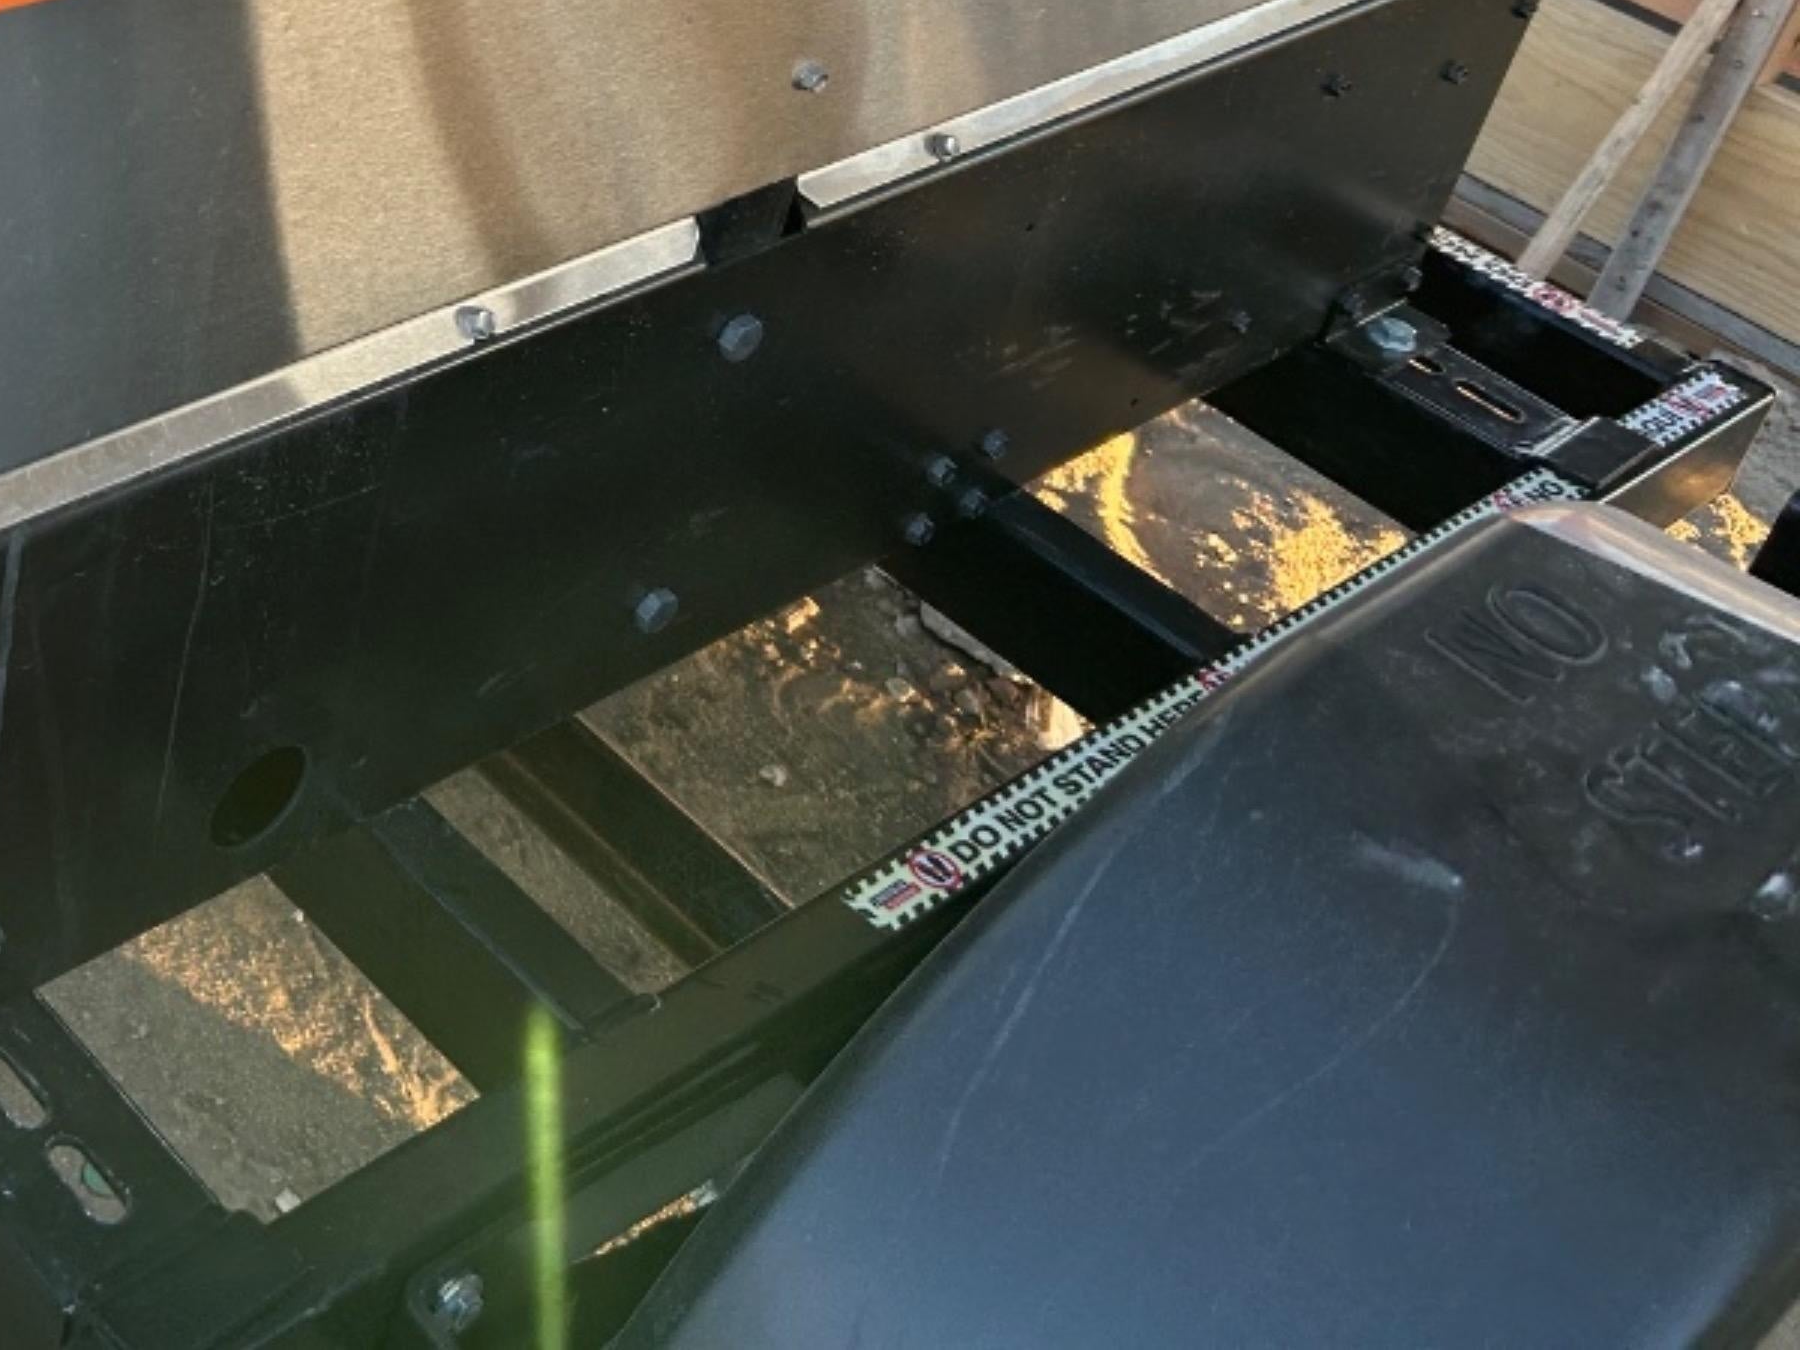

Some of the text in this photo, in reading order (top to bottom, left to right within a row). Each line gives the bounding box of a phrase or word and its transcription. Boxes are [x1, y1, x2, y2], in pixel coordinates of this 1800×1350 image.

[1424, 580, 1609, 706] NO
[947, 824, 1001, 865] DO
[996, 787, 1060, 833] NOT
[1053, 733, 1147, 797] STAND
